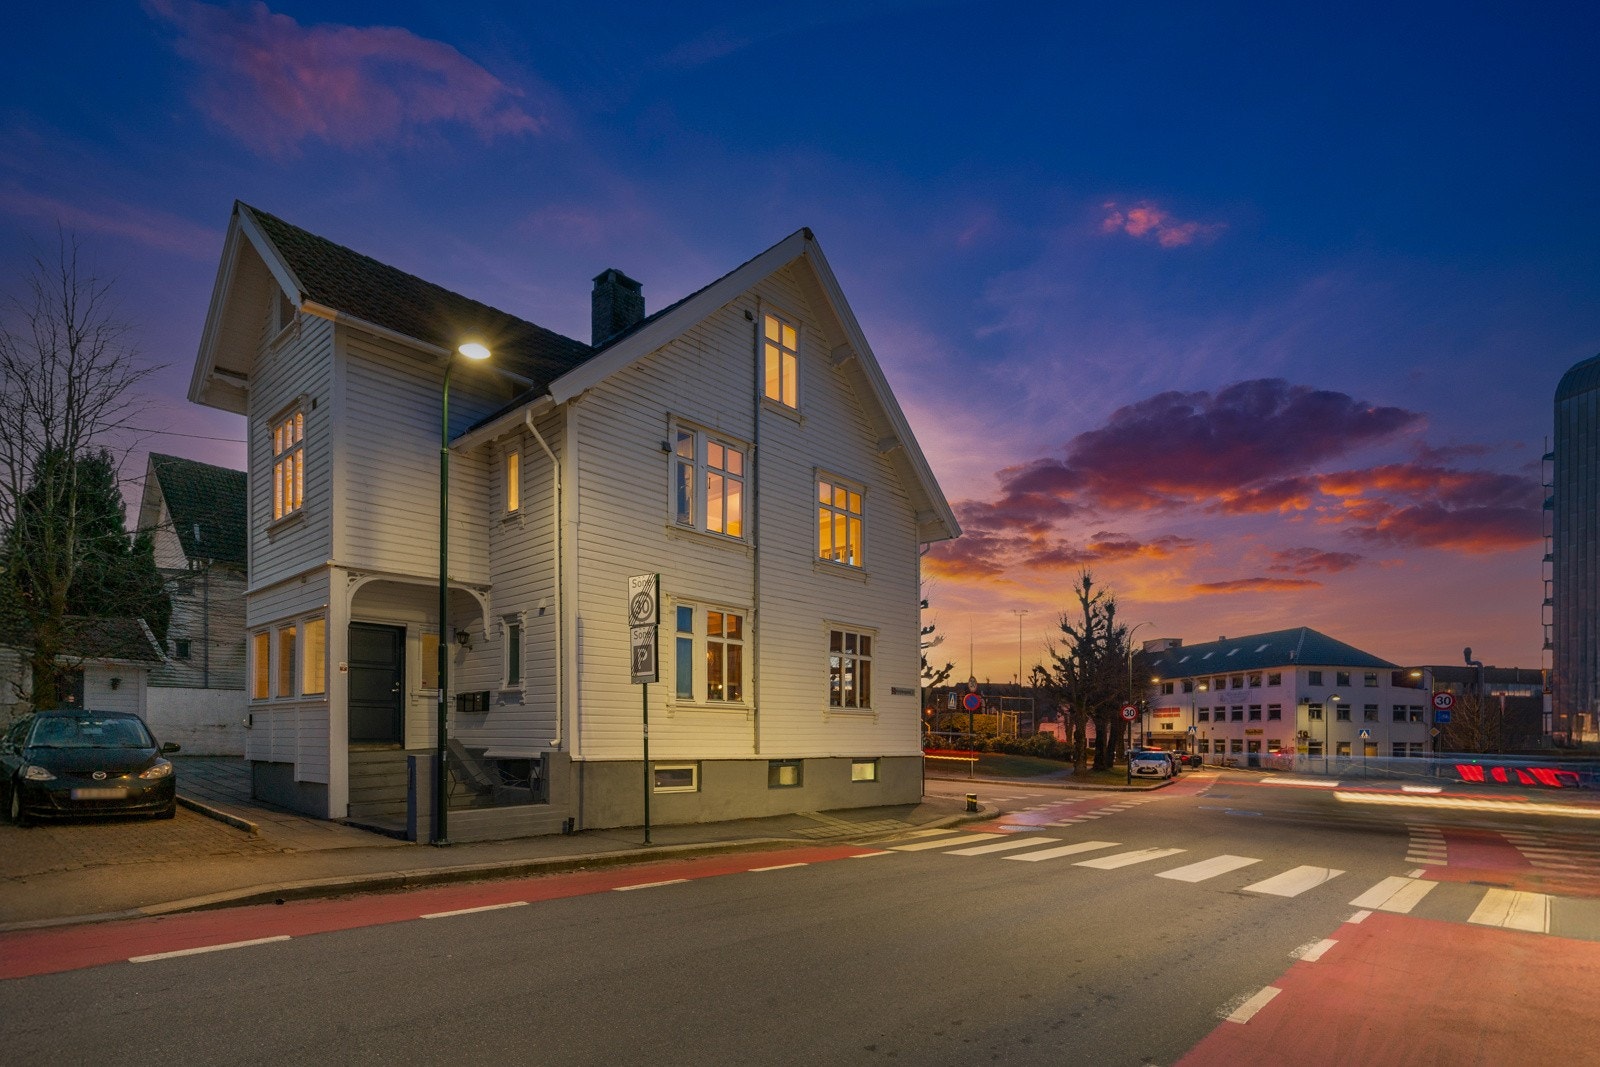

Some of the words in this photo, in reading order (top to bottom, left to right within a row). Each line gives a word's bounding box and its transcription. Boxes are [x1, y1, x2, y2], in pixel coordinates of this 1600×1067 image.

[638, 648, 648, 669] P
[1436, 696, 1451, 705] 30
[1124, 709, 1135, 717] 30
